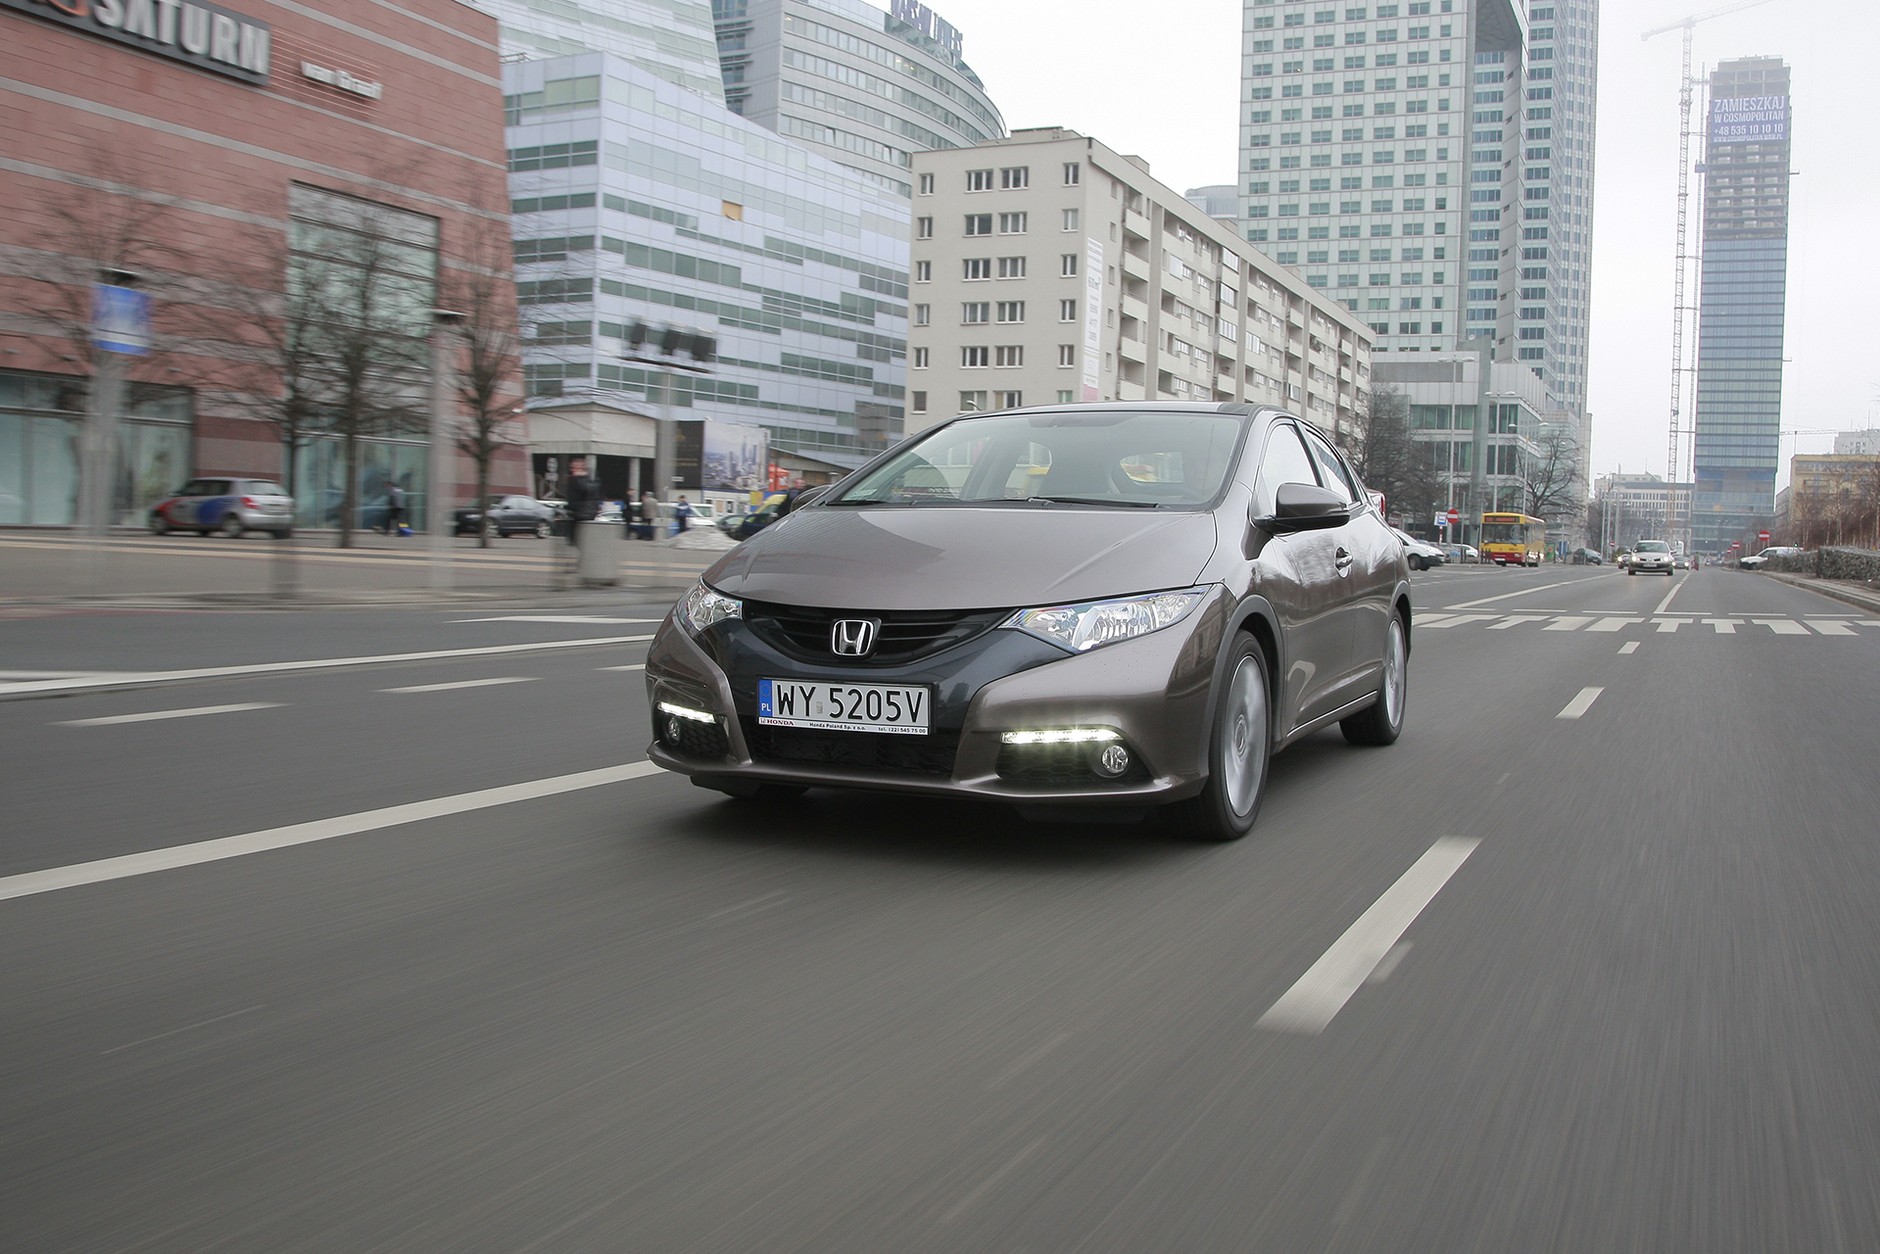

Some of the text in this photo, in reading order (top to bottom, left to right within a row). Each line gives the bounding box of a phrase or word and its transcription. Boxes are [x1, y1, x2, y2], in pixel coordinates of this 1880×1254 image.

[93, 0, 270, 75] SATURN
[1714, 96, 1785, 113] ZAMIESZKAJ
[1714, 111, 1784, 123] W COSMOPOLITAN
[1713, 126, 1729, 136] +48
[1749, 124, 1759, 134] 10
[1761, 124, 1771, 133] 10
[1774, 123, 1784, 133] 10
[761, 703, 771, 712] PL
[777, 685, 923, 723] WY 5205V
